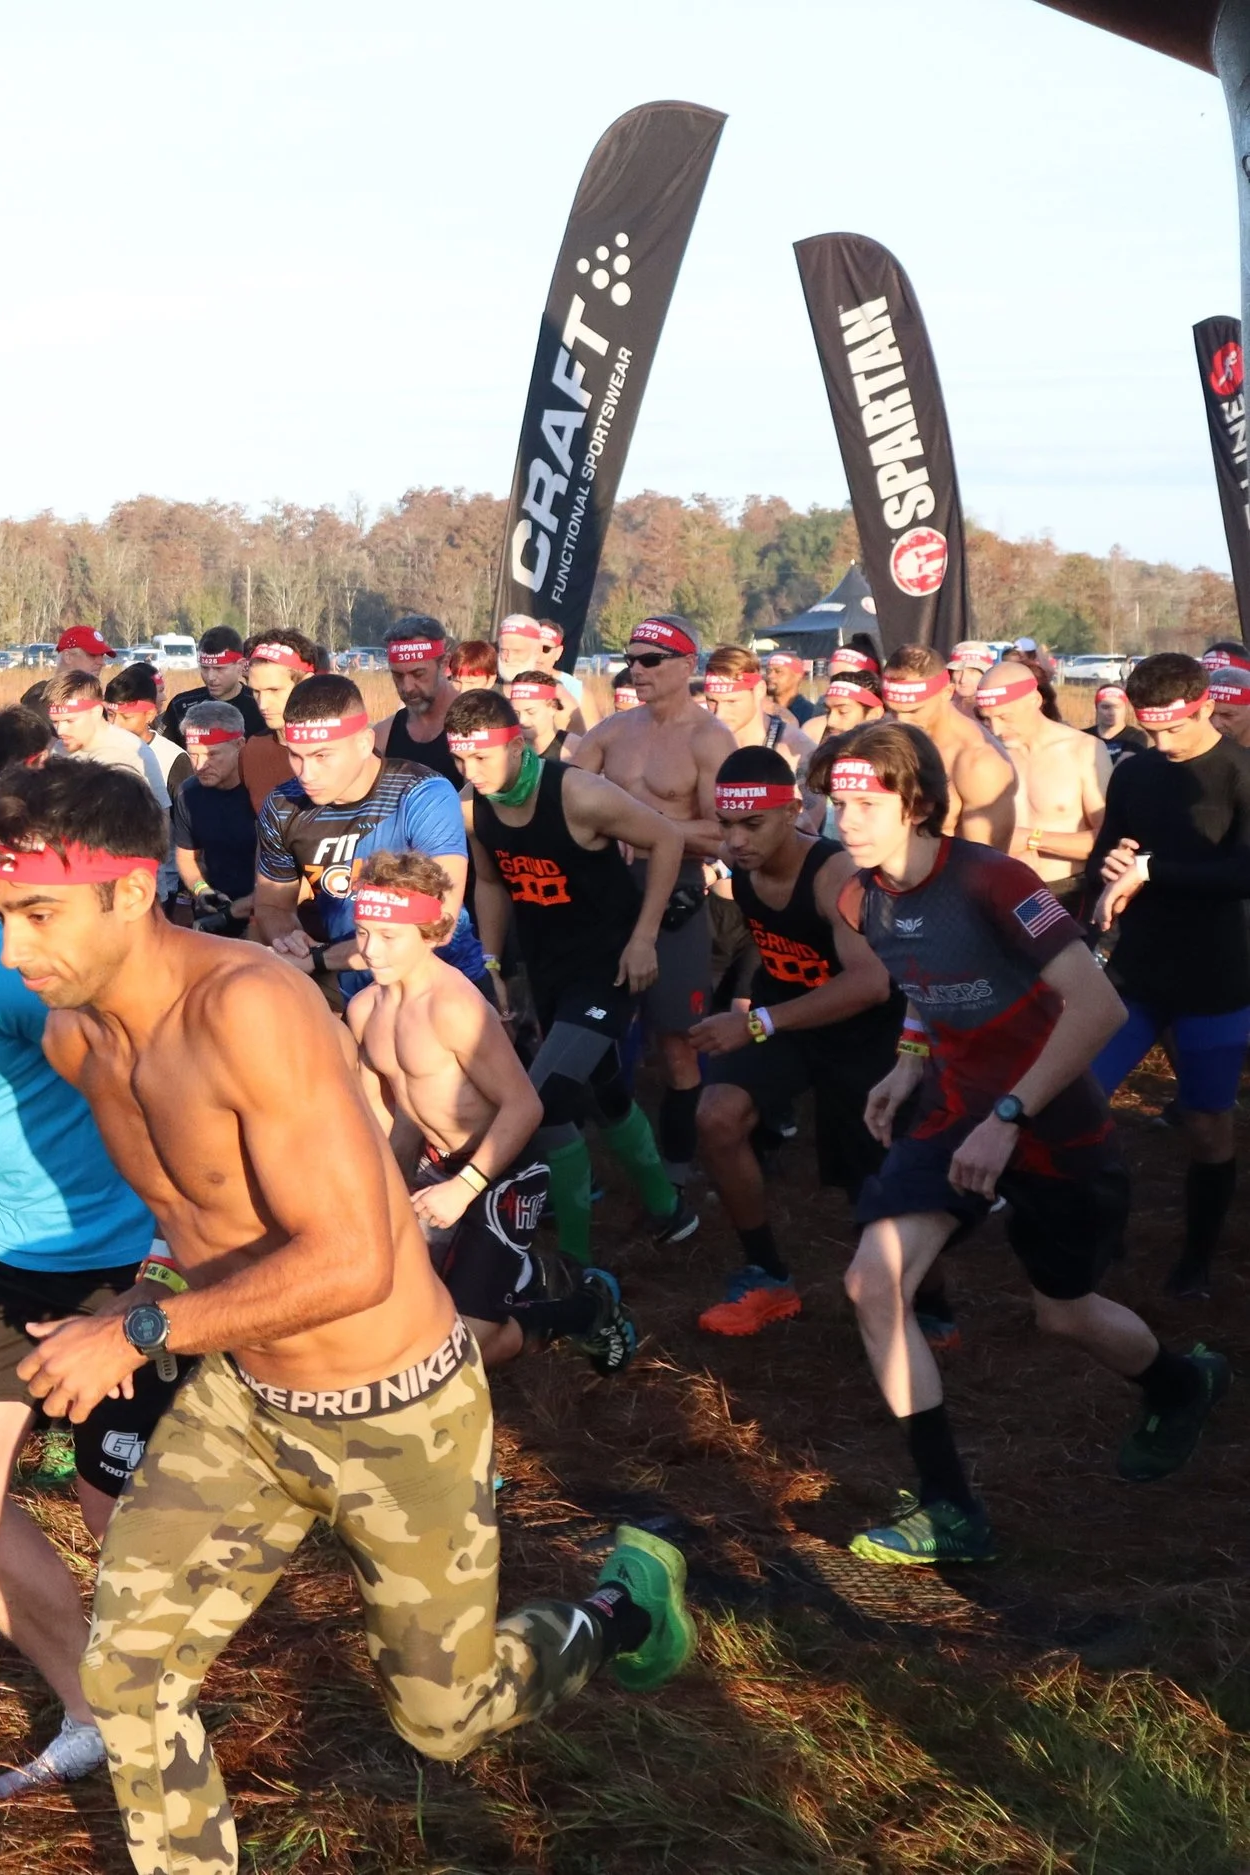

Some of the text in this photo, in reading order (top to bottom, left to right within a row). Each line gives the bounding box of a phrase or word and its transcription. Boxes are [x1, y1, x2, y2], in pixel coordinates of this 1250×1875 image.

[839, 296, 936, 530] SPARTAN
[511, 293, 610, 593] CRAFT
[551, 346, 633, 604] FUNCTIONAL SPORTSWEAR
[398, 644, 433, 653] SPARTAN
[397, 653, 425, 661] 3016
[292, 730, 329, 741] 3140
[832, 778, 868, 790] 3024
[723, 787, 767, 798] SPARTAN
[722, 800, 755, 810] 3347
[313, 833, 361, 865] FIT
[500, 857, 562, 877] GRIND
[358, 904, 391, 918] 3023
[289, 1385, 372, 1416] PRO
[379, 1345, 456, 1410] NIKE
